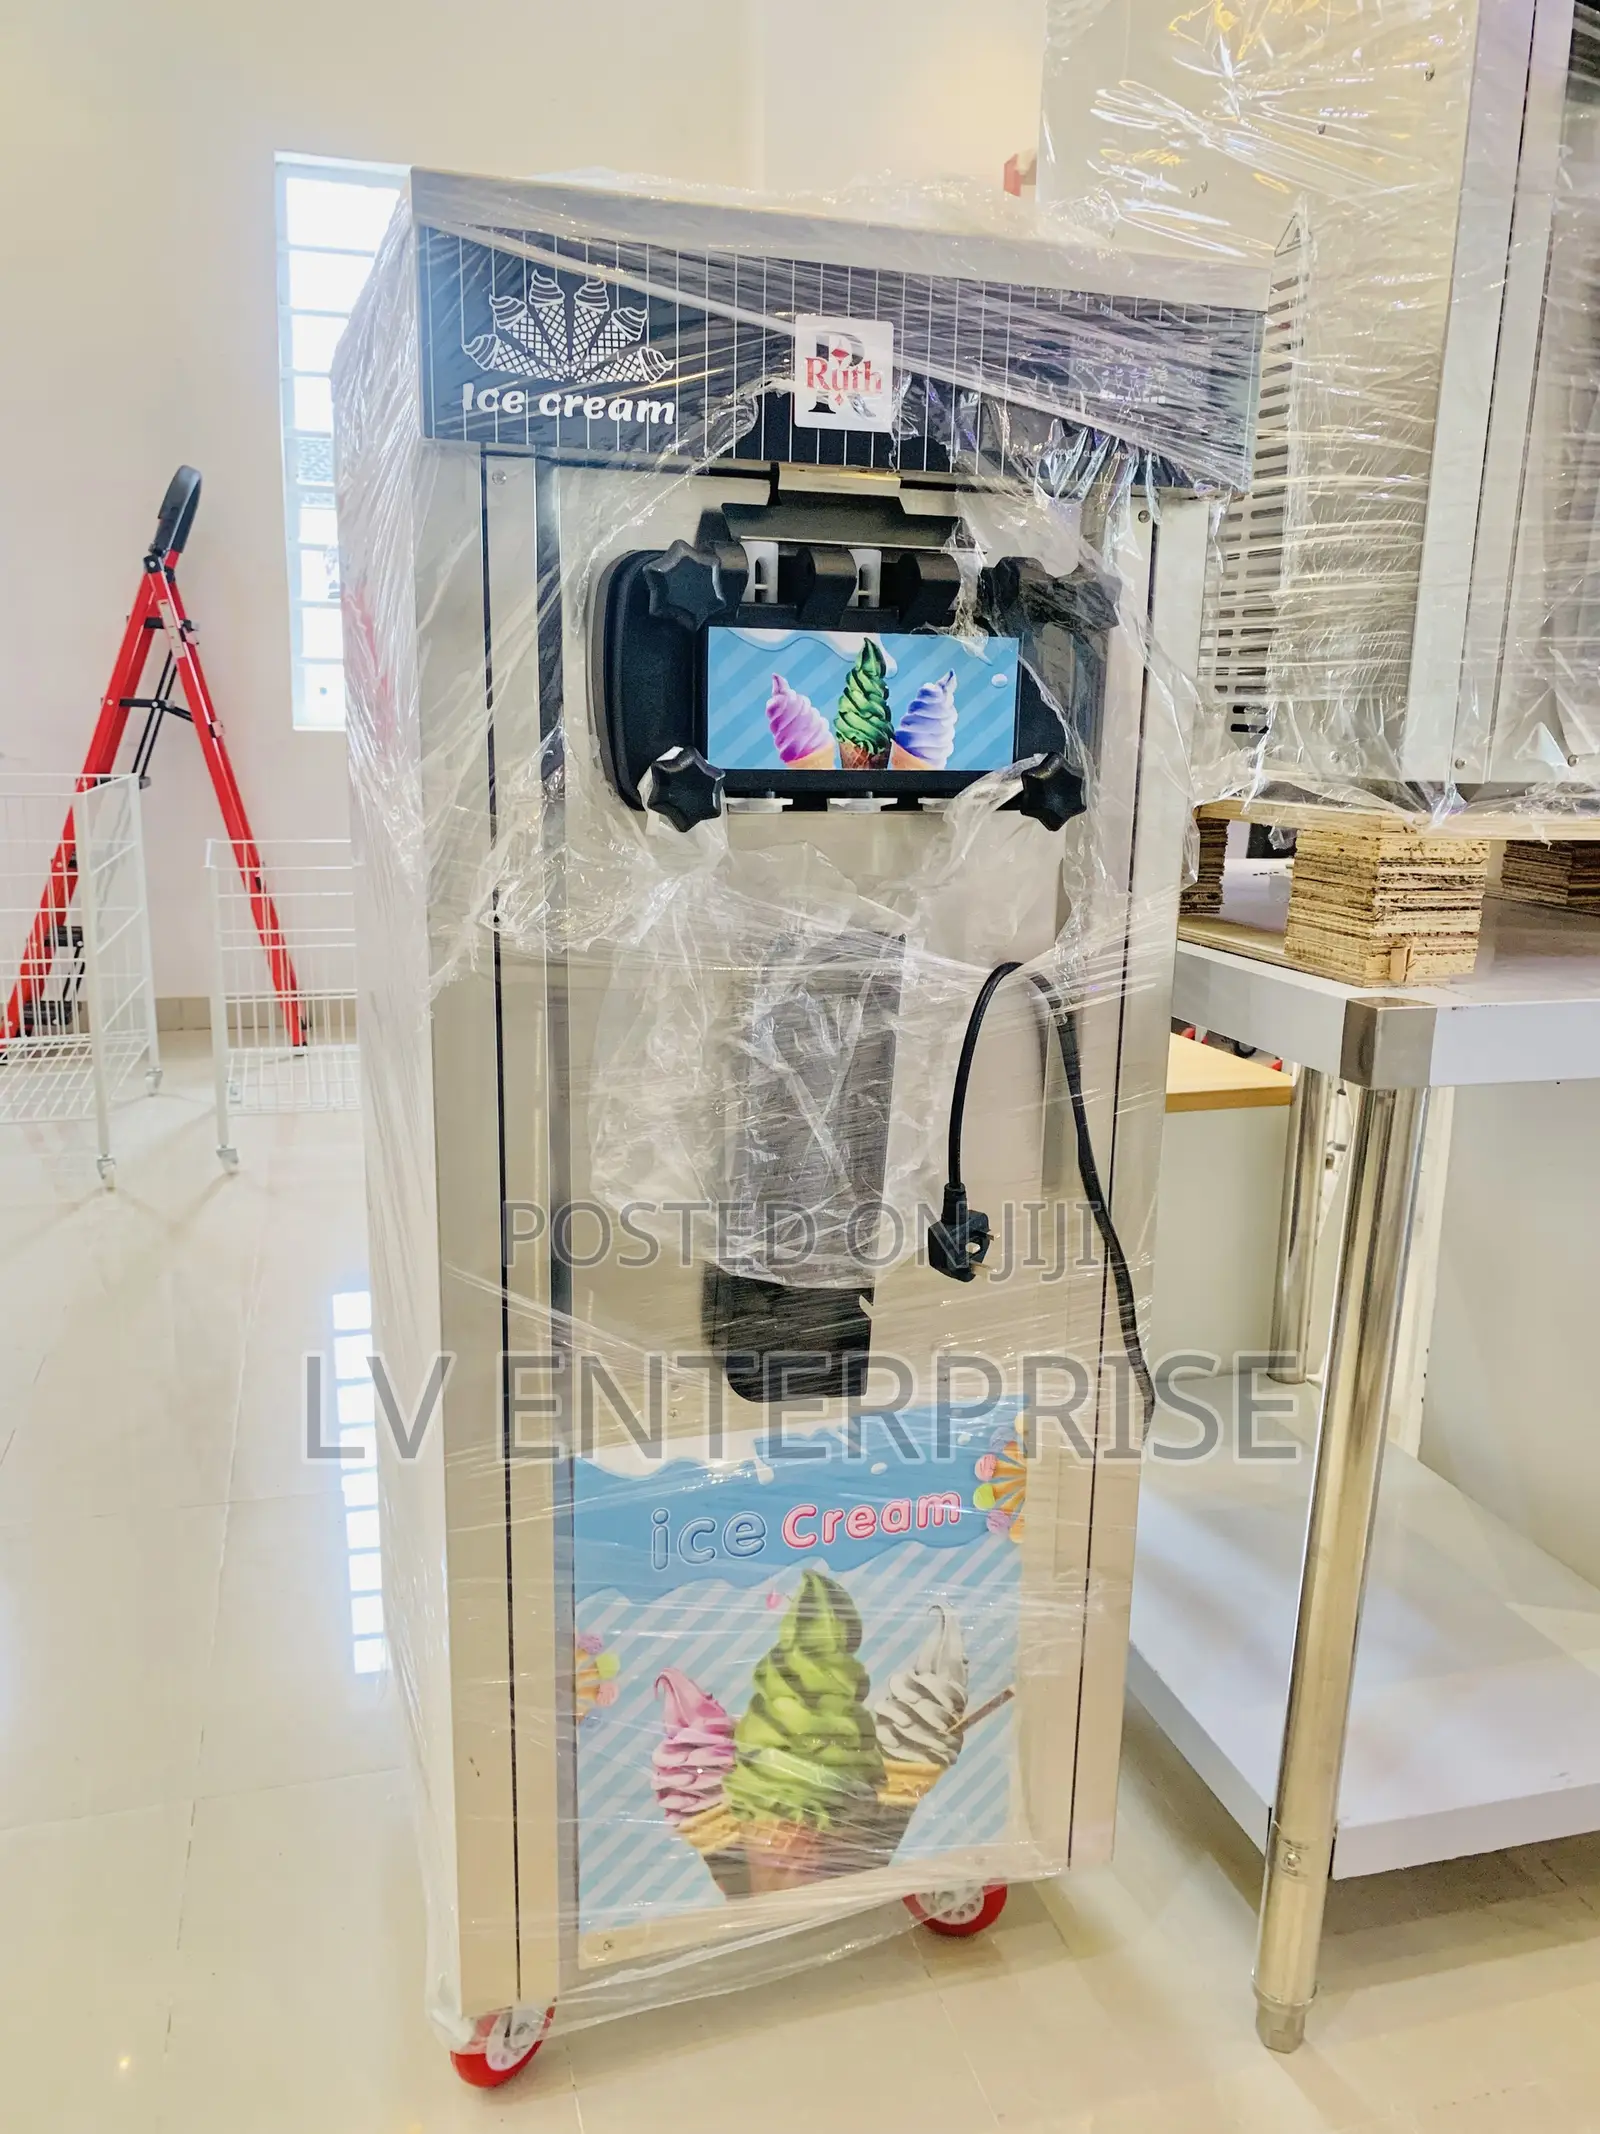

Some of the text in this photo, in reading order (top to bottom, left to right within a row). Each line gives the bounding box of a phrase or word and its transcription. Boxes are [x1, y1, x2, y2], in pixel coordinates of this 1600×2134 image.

[804, 356, 883, 394] Ruth
[462, 382, 676, 425] Ice cream
[650, 1490, 963, 1571] ice Cream
